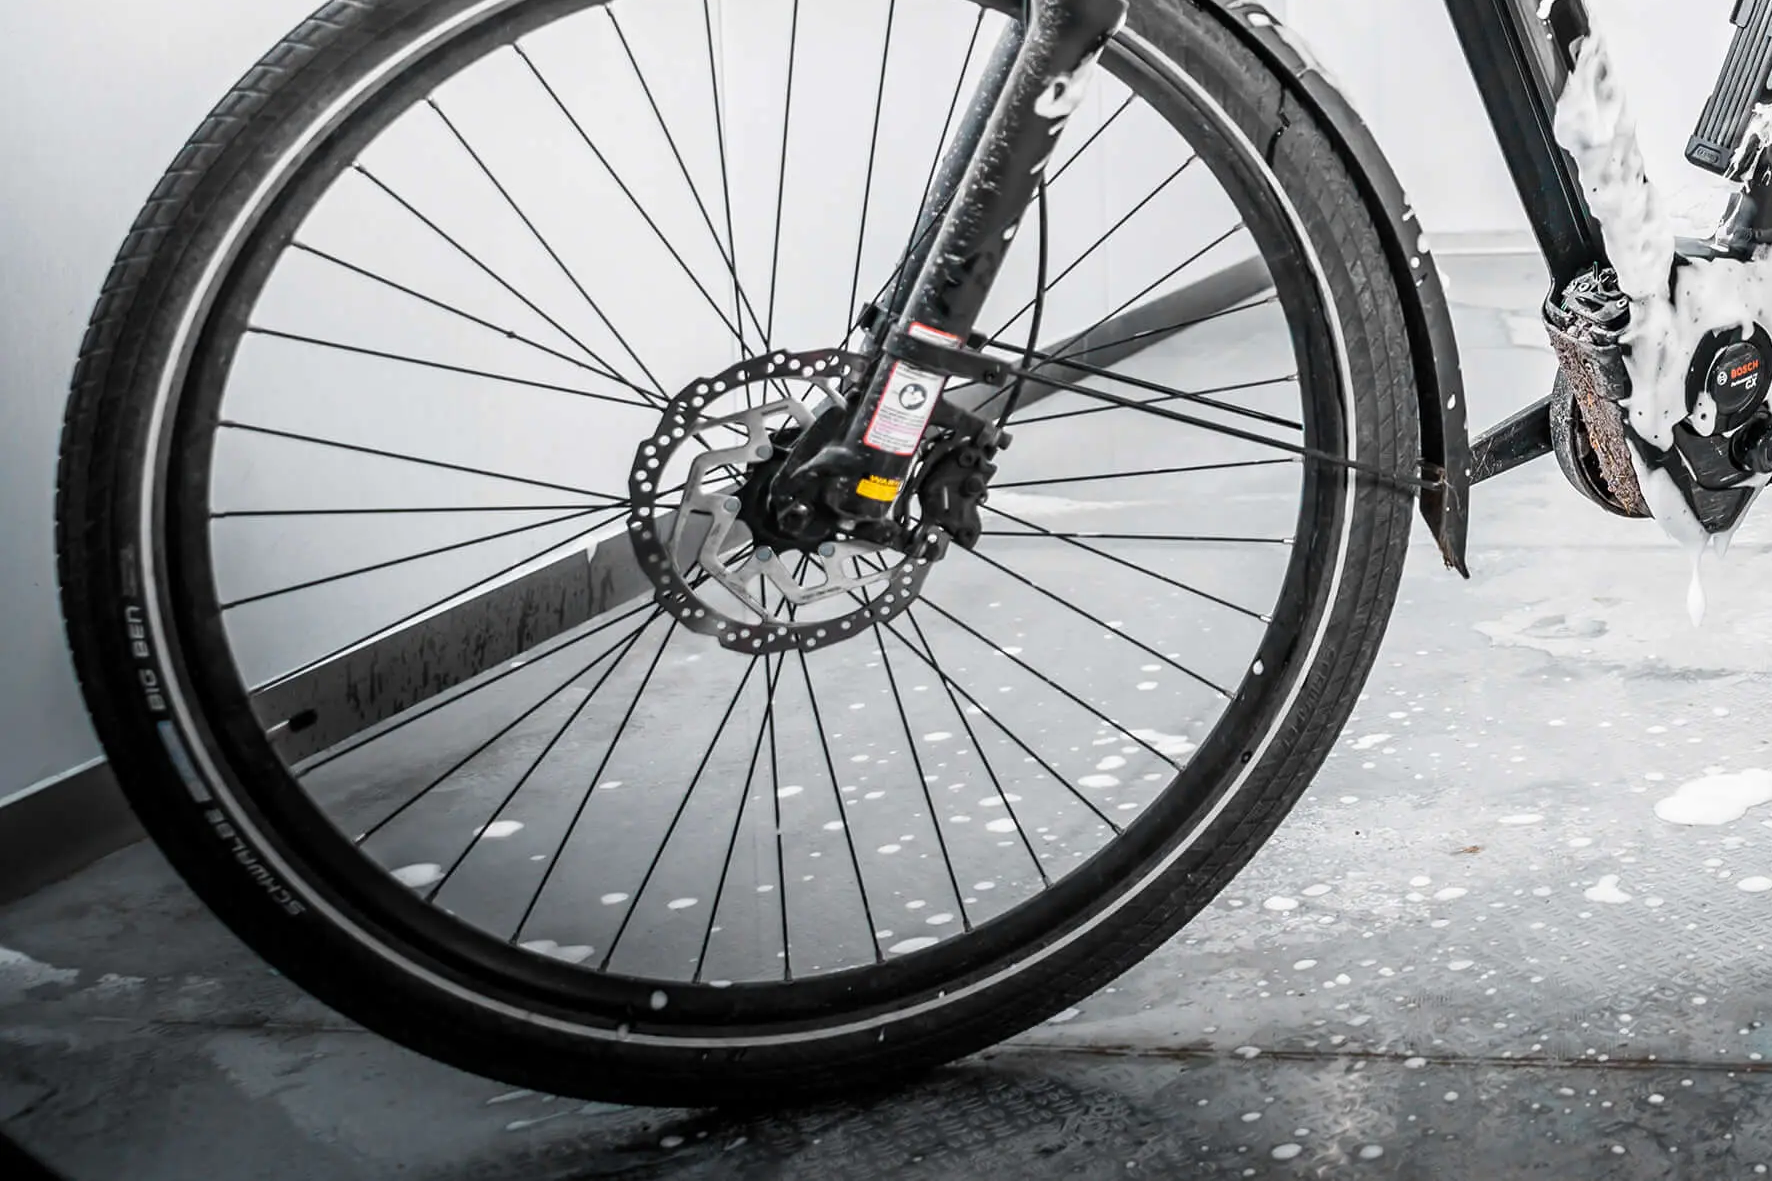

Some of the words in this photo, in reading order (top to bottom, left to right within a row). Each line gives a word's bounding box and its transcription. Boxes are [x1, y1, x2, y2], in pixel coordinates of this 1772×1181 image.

[1730, 359, 1759, 379] BOSCH
[139, 667, 166, 711] BIG
[204, 807, 306, 917] SCHWALBE
